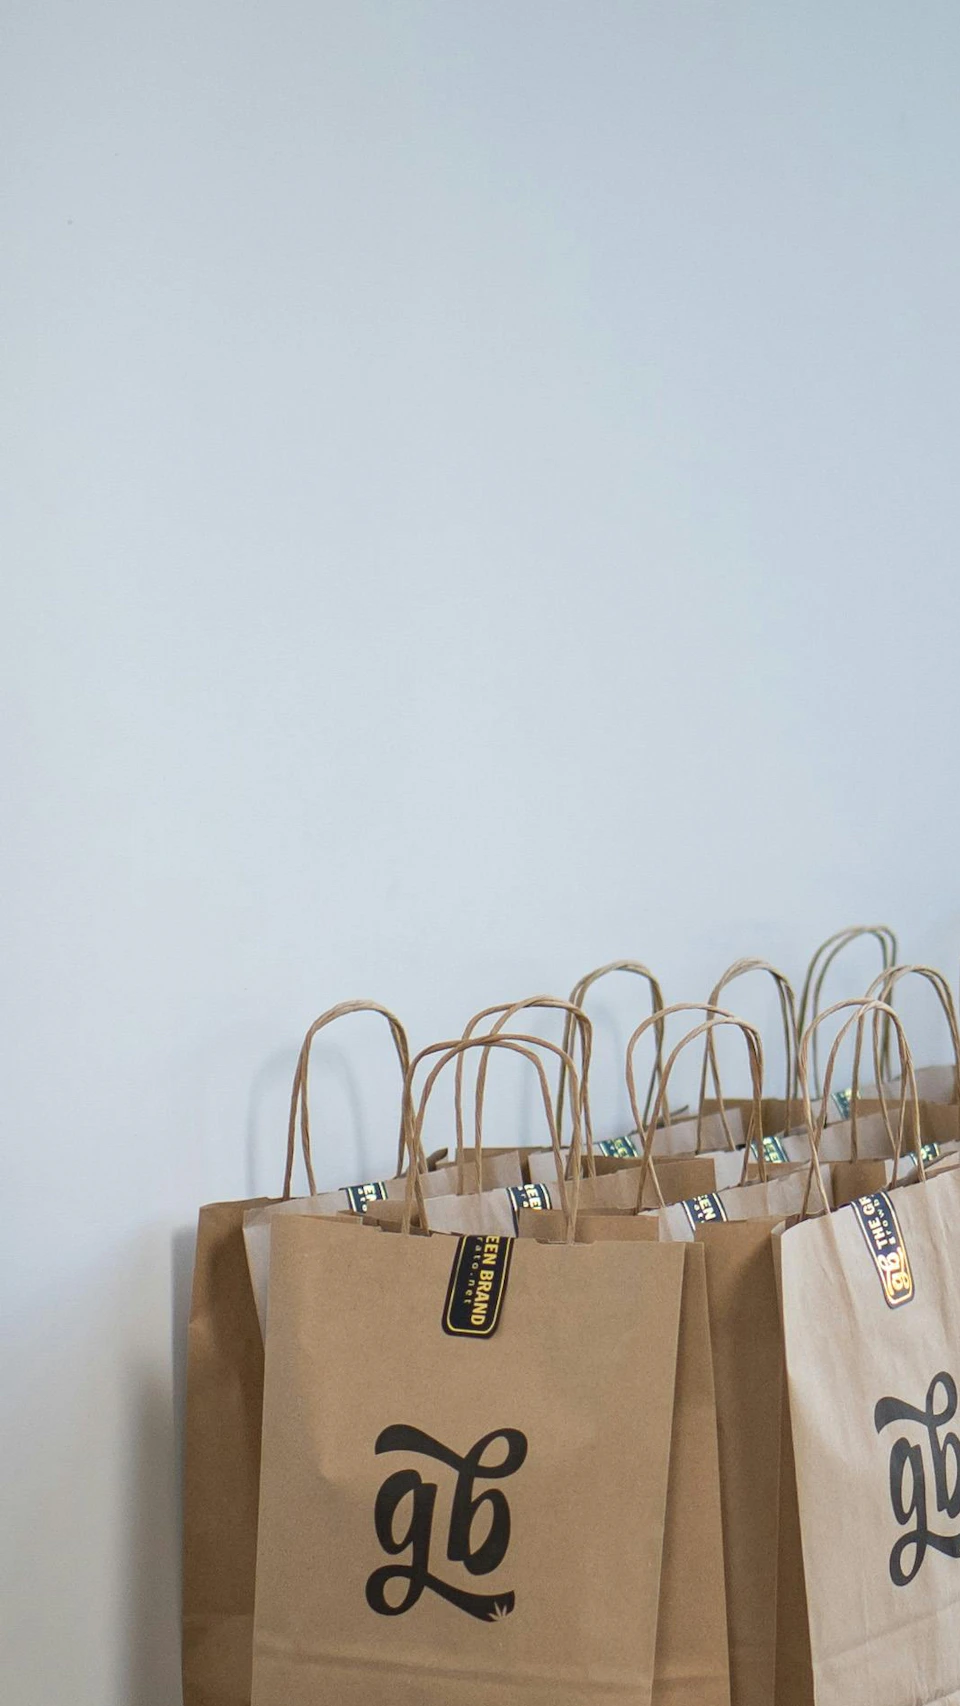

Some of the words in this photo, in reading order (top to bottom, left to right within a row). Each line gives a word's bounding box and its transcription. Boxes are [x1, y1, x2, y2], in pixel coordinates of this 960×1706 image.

[868, 1217, 888, 1250] THE
[872, 1195, 896, 1245] growb
[470, 1269, 495, 1326] BRAND
[364, 1423, 529, 1623] gb
